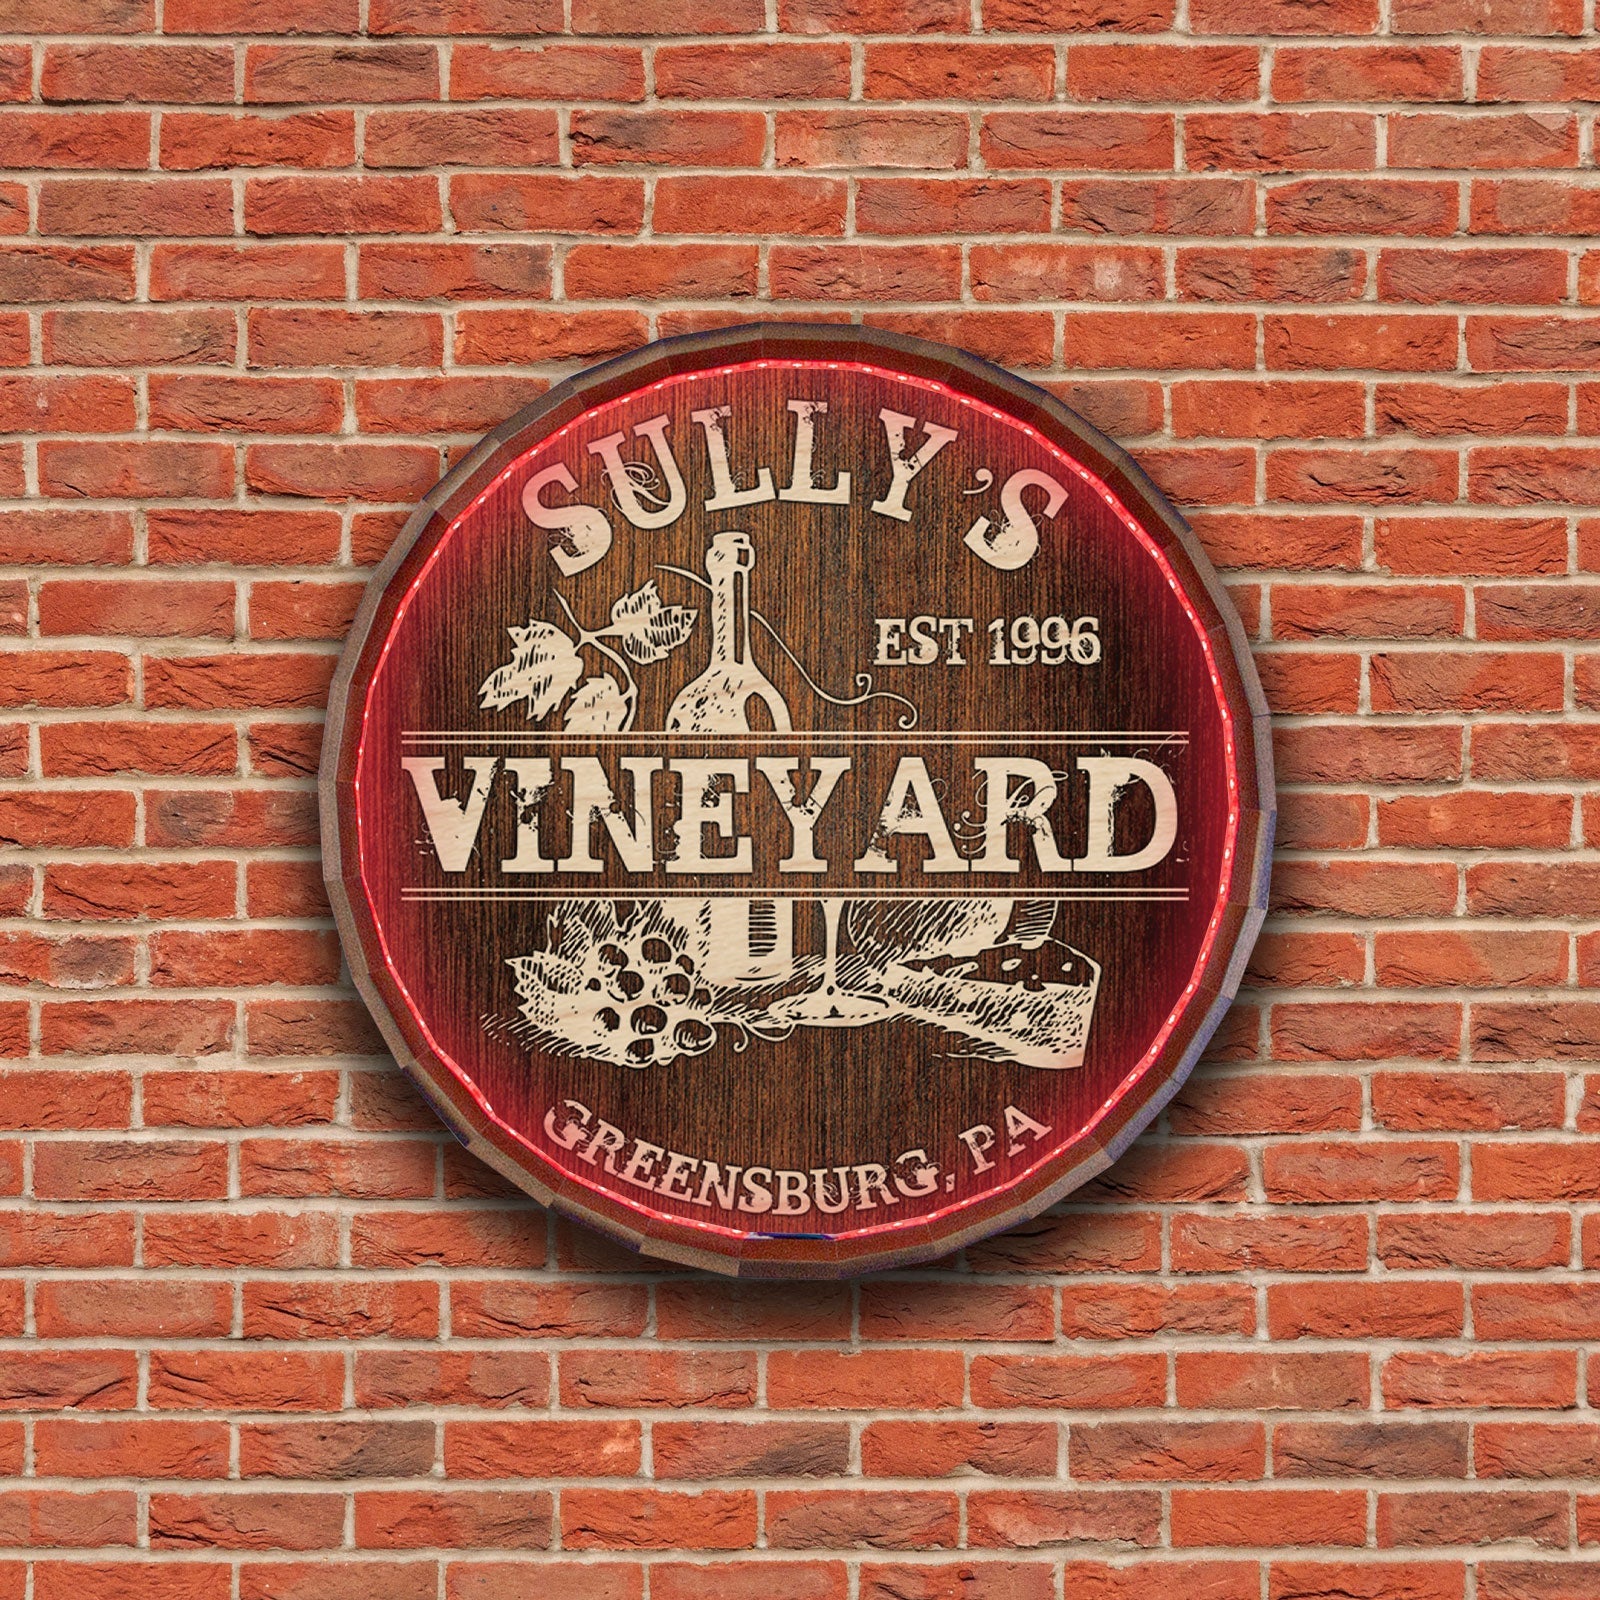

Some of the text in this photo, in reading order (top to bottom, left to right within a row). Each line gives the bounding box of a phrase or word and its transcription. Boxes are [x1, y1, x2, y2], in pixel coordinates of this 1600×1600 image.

[522, 400, 1069, 577] SULLY'S
[873, 616, 1102, 666] EST 1996
[402, 756, 1178, 873] VINEYARD
[543, 1100, 1052, 1215] GREENSBURG, PA
